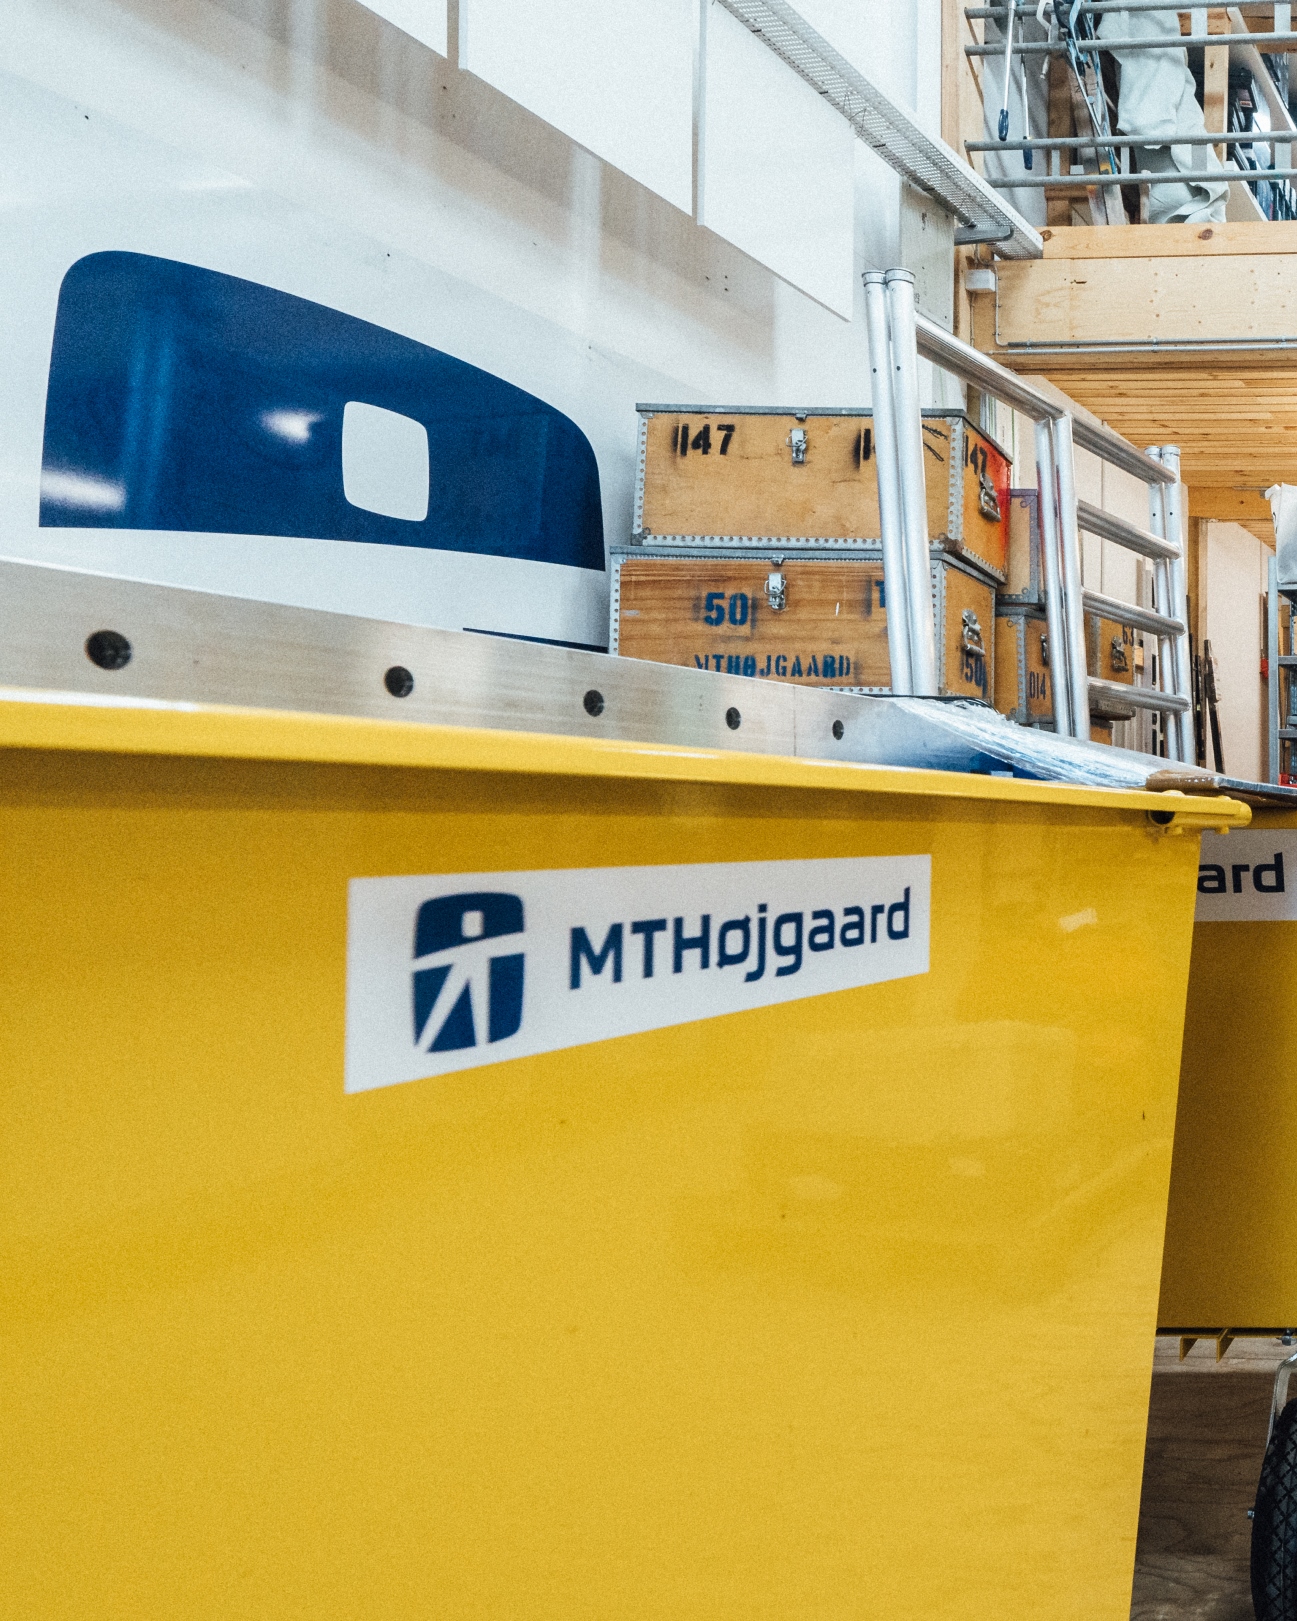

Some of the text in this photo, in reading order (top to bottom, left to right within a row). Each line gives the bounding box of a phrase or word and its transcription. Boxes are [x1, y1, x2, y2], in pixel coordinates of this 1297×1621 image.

[680, 423, 736, 457] 147
[704, 592, 749, 627] 50
[569, 886, 911, 990] MTHøjgaard
